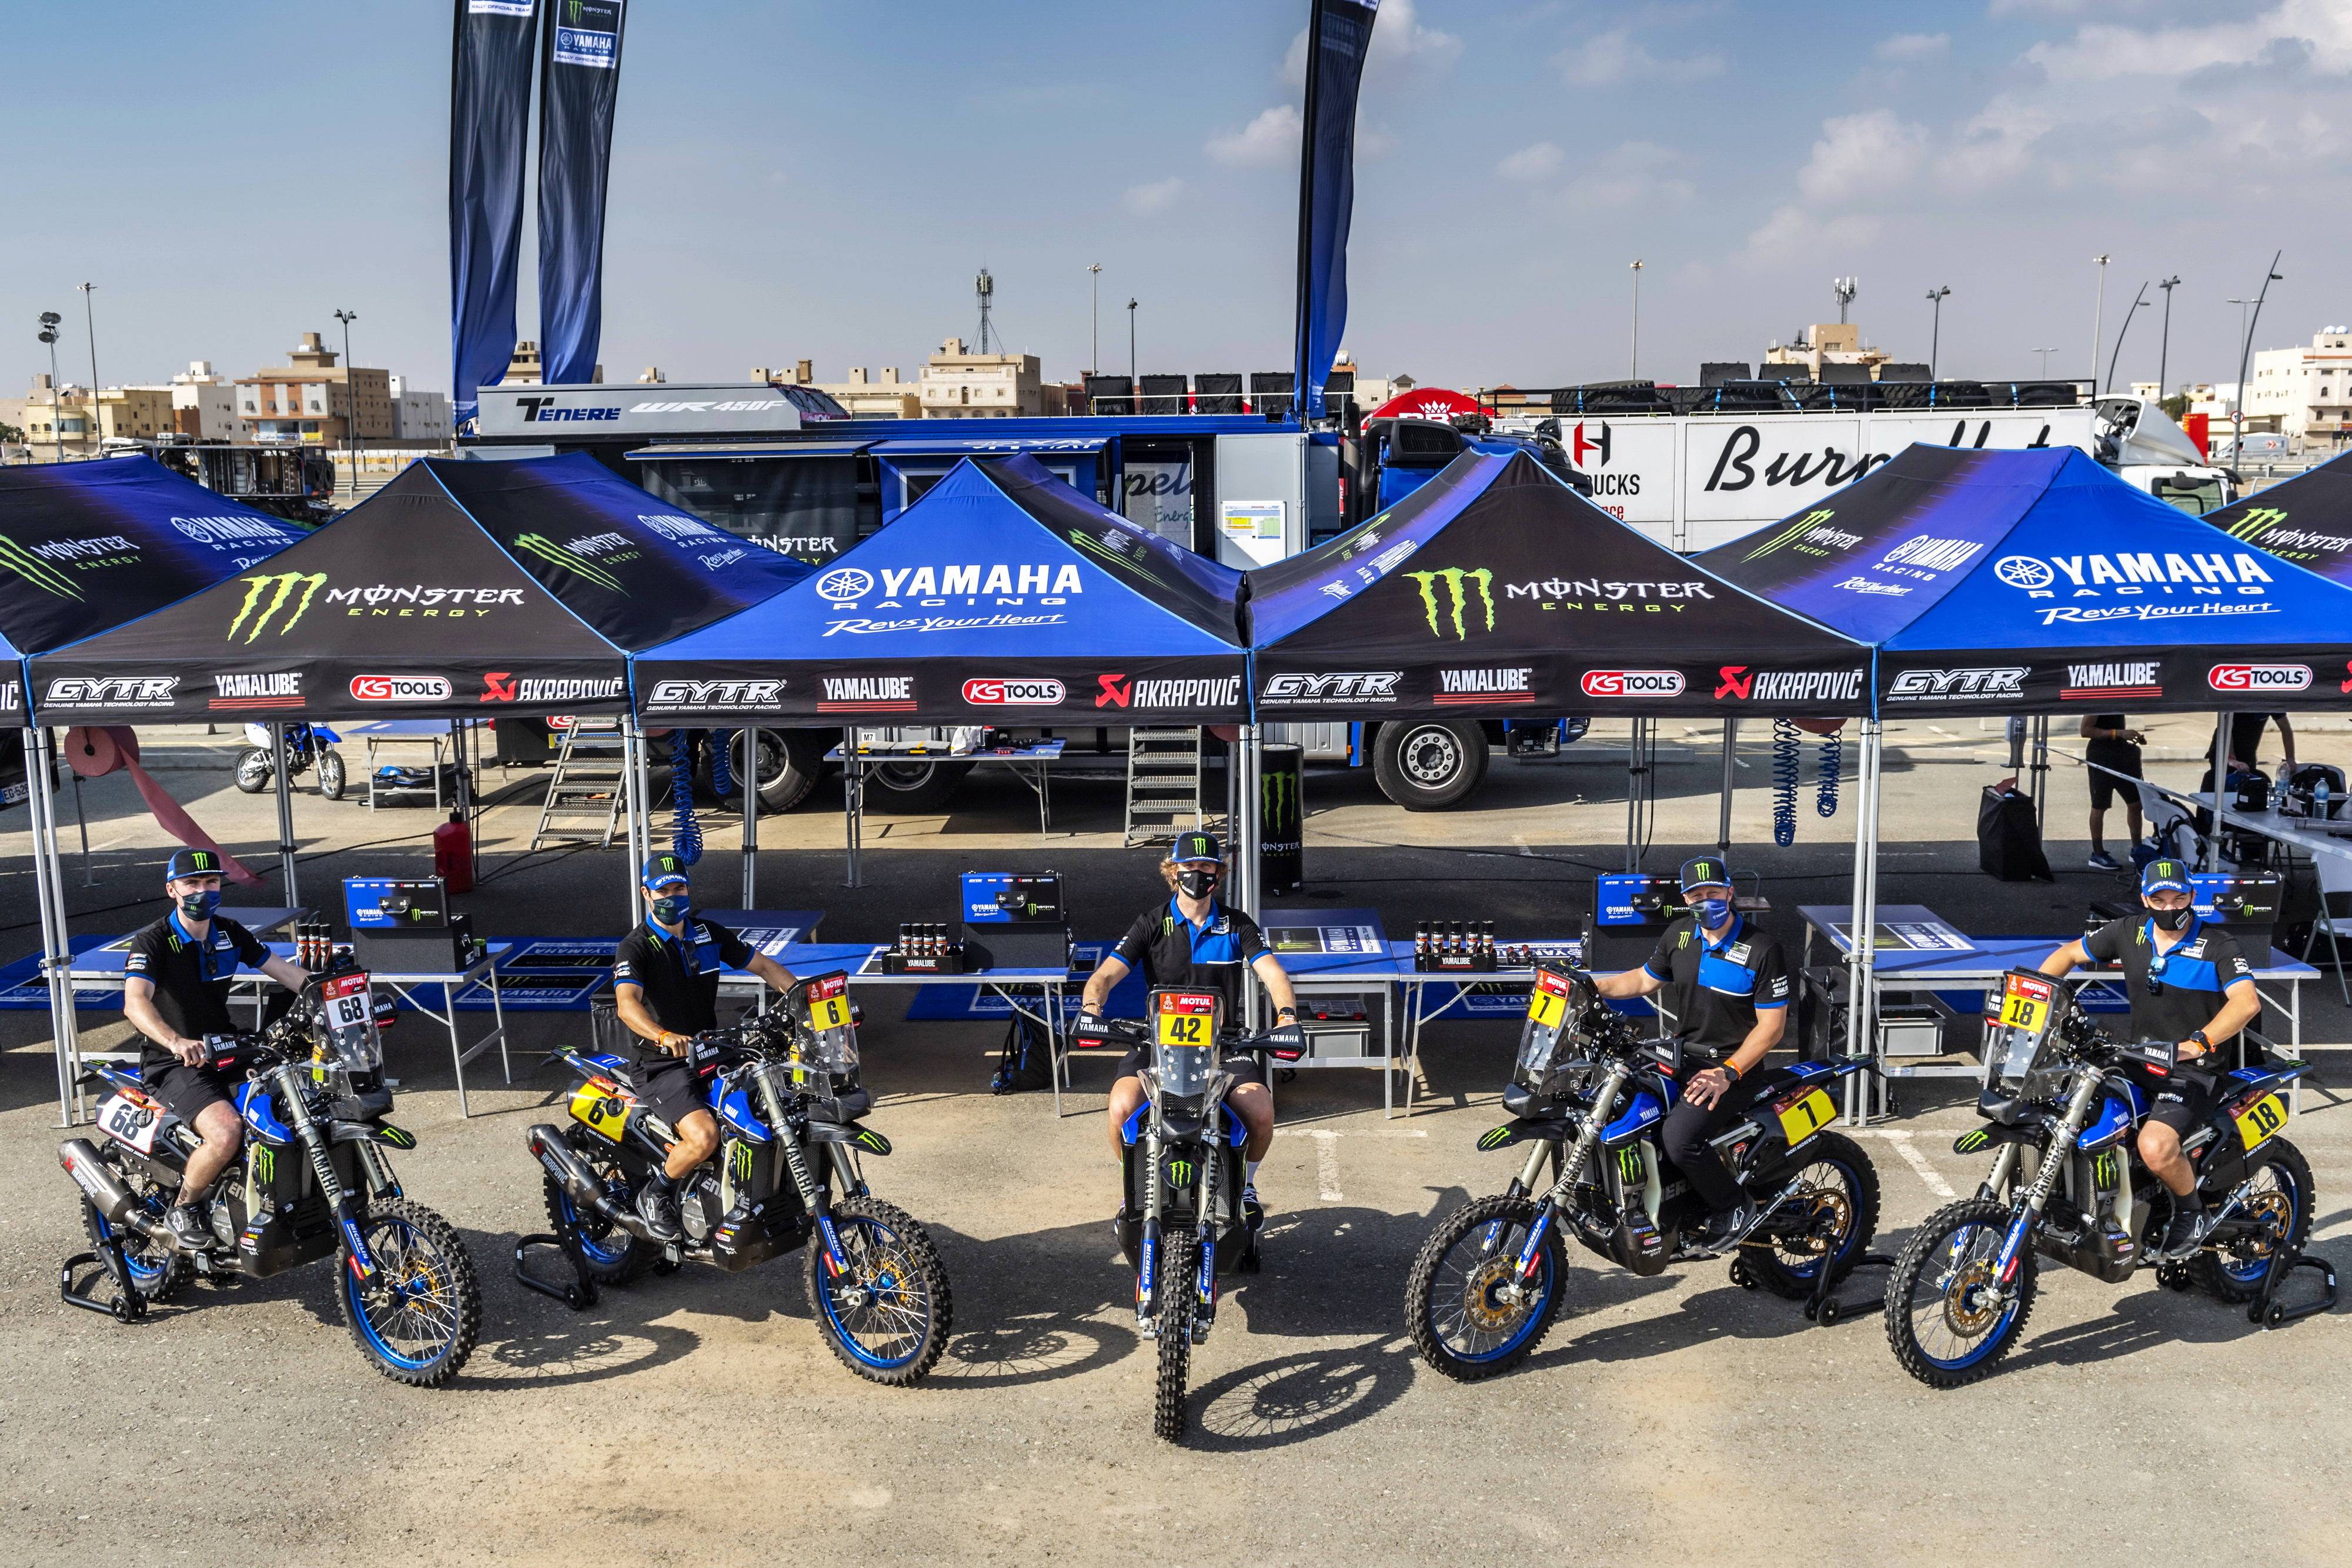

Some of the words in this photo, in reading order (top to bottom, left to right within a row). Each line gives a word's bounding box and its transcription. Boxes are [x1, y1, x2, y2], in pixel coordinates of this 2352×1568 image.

[564, 46, 609, 54] RACING
[573, 34, 612, 49] YAMAHA
[629, 402, 717, 412] WR
[712, 400, 787, 411] 450F
[1587, 474, 1639, 496] UCKS
[192, 516, 287, 539] YAMAHA
[214, 537, 294, 551] RACING
[563, 531, 634, 556] MONSTER
[678, 536, 728, 549] RACING
[747, 534, 838, 554] ONSTER
[1804, 526, 1863, 550] MONSTER
[2260, 528, 2352, 553] MONSTER
[31, 535, 141, 561] MONSTER
[1793, 543, 1830, 557] ENERGY
[1900, 538, 1984, 571] YAMAHA
[75, 554, 143, 571] ENERGY
[603, 550, 644, 566] ENERGY
[1872, 563, 1936, 581] RACING
[2051, 553, 2274, 584] YAMAHA
[880, 563, 1083, 596] YAMAHA
[325, 584, 525, 606] MONSTER
[1505, 577, 1715, 600] MONSTER
[2029, 586, 2265, 599] RACING
[833, 597, 1067, 610] RACING
[1542, 602, 1685, 613] ENERGY
[348, 608, 490, 617] ENERGY
[2034, 607, 2130, 625] Revs
[2133, 604, 2200, 620] Your
[2203, 601, 2273, 614] Heart
[821, 616, 922, 637] Revs
[918, 614, 990, 633] Your
[987, 613, 1065, 626] Heart
[1262, 671, 1401, 697] GYTR
[1440, 668, 1528, 692] YAMALUBE
[1589, 674, 1623, 691] KS
[1623, 676, 1676, 690] TOOLS
[1889, 667, 2029, 694] GYTR
[2067, 663, 2156, 687] YAMALUBE
[2216, 668, 2251, 686] KS
[2251, 670, 2304, 684] TOOLS
[46, 677, 178, 701] GYTR
[215, 673, 299, 696] YAMALUBE
[358, 679, 392, 696] KS
[392, 681, 443, 696] TOOLS
[648, 680, 784, 704] GYTR
[823, 677, 911, 700] YAMALUBE
[970, 683, 1004, 700] KS
[1004, 684, 1057, 698] TOOLS
[863, 733, 874, 741] M7
[1261, 841, 1300, 852] ONSTER
[907, 959, 936, 968] YAMALUBE
[1442, 957, 1471, 965] YAMALUBE
[341, 976, 365, 987] MOTUL
[823, 978, 843, 989] MOTUL
[1546, 975, 1567, 990] MOTUL
[2022, 981, 2049, 994] MOTUL
[338, 997, 365, 1023] 68
[374, 1002, 393, 1013] MAHA
[1180, 997, 1210, 1006] MOTUL
[1538, 995, 1551, 1019] 7
[826, 1000, 840, 1024] 6
[2009, 999, 2035, 1026] 18
[1079, 1022, 1108, 1033] YAMAHA
[1170, 1017, 1201, 1042] 42
[213, 1040, 237, 1051] YAMAHA
[1270, 1034, 1299, 1043] YAMAHA
[697, 1047, 719, 1061] YAMAHA
[1656, 1045, 1673, 1061] YAMAHA
[2144, 1047, 2170, 1061] YAMAHA
[588, 1096, 609, 1125] 6
[1638, 1105, 1660, 1121] YAMAHA
[1796, 1100, 1818, 1128] 7
[109, 1104, 139, 1141] 68
[2247, 1102, 2280, 1138] 18
[586, 1127, 597, 1138] CAIMI
[596, 1132, 610, 1144] FRANCO
[120, 1143, 134, 1154] CANNEY
[1785, 1146, 1798, 1158] SHORT
[1796, 1137, 1813, 1151] ANDREW
[2257, 1142, 2267, 1151] ROSS
[309, 1140, 340, 1198] YAMAHA
[784, 1141, 815, 1199] YAMAHA
[349, 1223, 369, 1259] MICHELIN
[826, 1219, 843, 1257] MICHELIN
[1524, 1218, 1543, 1255] MICHELIN
